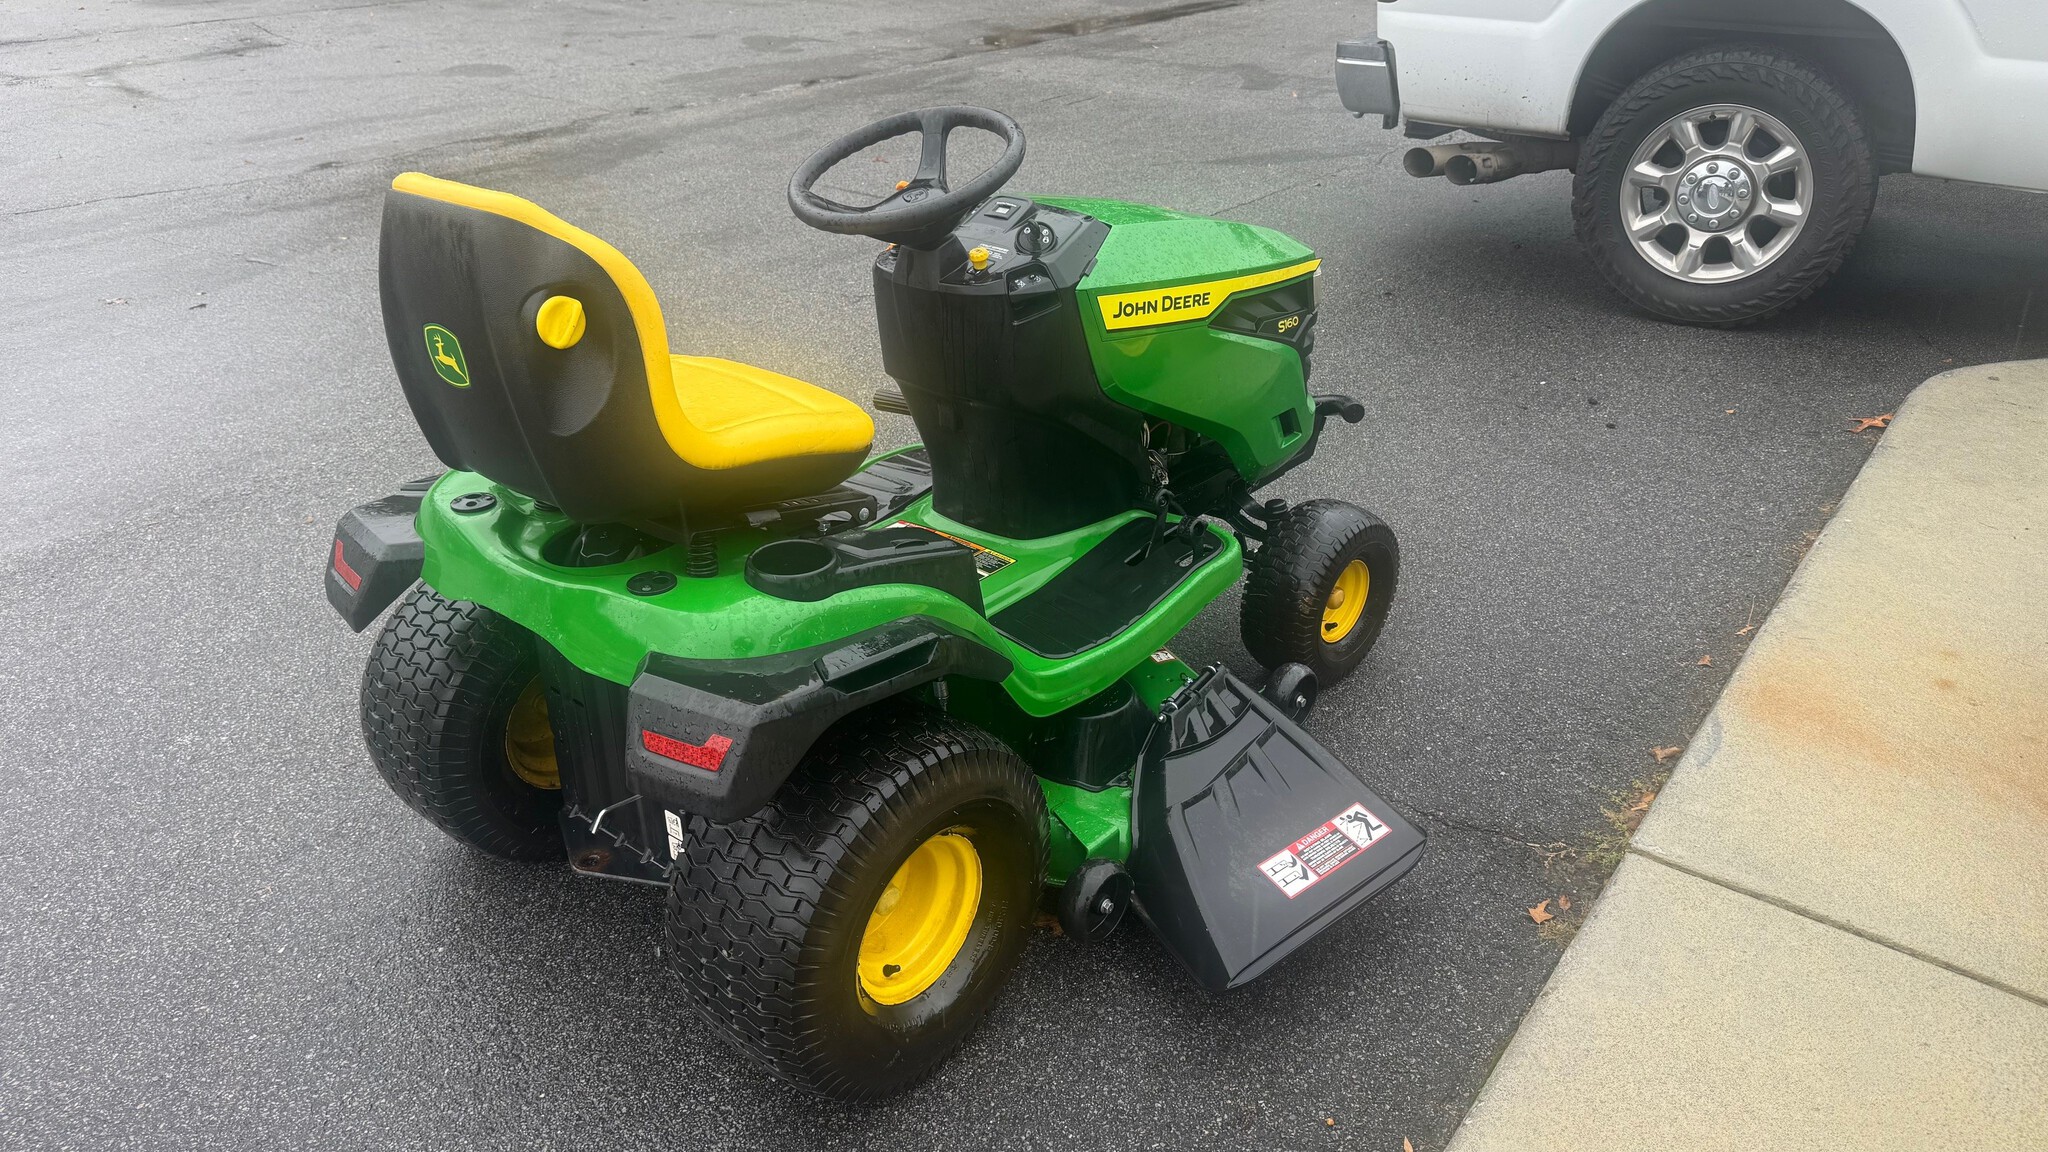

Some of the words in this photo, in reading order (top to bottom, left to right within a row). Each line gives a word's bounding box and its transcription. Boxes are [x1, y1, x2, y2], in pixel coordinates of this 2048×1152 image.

[1112, 299, 1158, 319] JOHN
[1161, 292, 1211, 312] DEERE
[1277, 315, 1299, 333] S160
[1301, 826, 1330, 847] DANGER
